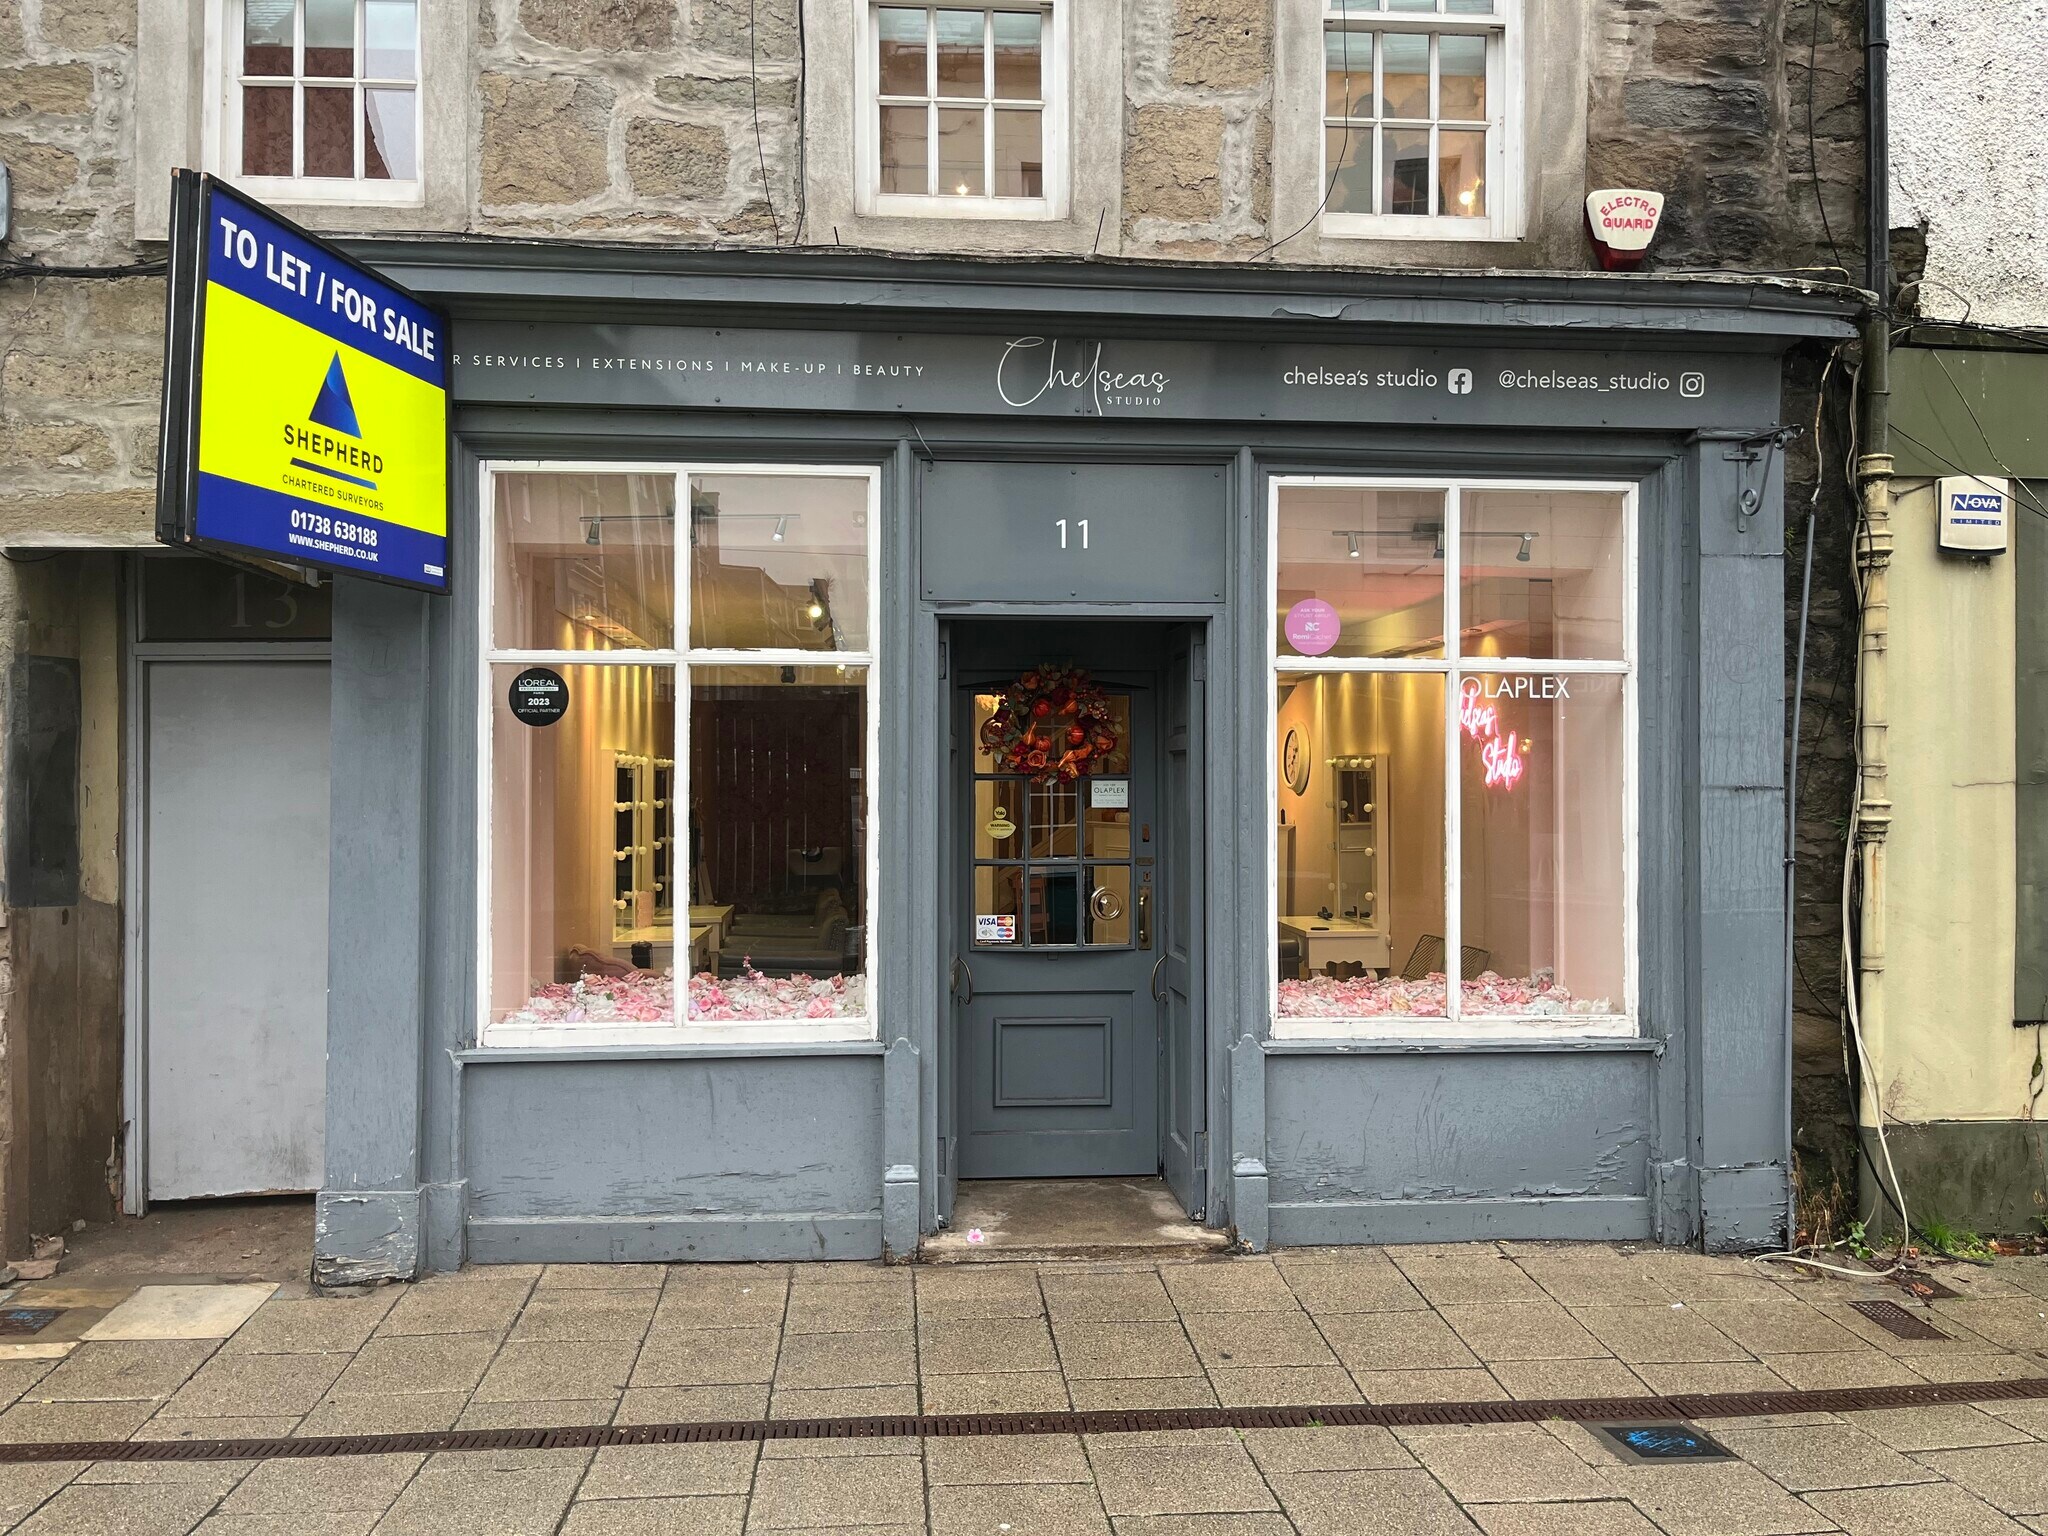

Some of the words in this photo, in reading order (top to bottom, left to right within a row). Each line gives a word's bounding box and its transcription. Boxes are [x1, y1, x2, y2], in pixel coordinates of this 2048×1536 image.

[1600, 196, 1657, 217] ELECTRO
[1602, 217, 1654, 229] GUARD
[220, 217, 258, 269] TO
[266, 242, 311, 298] LET
[316, 271, 326, 305] /
[331, 278, 377, 333] FOR
[383, 307, 435, 361] SALE
[473, 355, 565, 368] SERVICES
[592, 358, 714, 371] EXTENSIONS
[741, 361, 826, 374] MAKE-UP
[853, 364, 925, 377] BEAUTY
[997, 336, 1171, 417] Chelseas
[1283, 365, 1369, 386] chelsea's
[1376, 367, 1438, 387] studio
[1499, 369, 1670, 392] @chelseas_studio
[1106, 396, 1161, 406] STUDIO
[283, 424, 384, 474] SHEPHERD
[282, 474, 335, 497] CHARTERED
[337, 490, 384, 511] SURVEYORS
[1952, 495, 2001, 510] NOVA
[291, 509, 331, 536] 01738
[334, 520, 378, 547] 638188
[1055, 519, 1089, 549] 11
[288, 533, 379, 562] WWW.SHEPHERD.CO.UK
[229, 571, 298, 628] 13
[1460, 676, 1571, 699] OLAPLEX
[527, 698, 550, 706] 2023
[1093, 786, 1125, 794] OLAPLEX
[978, 917, 996, 926] VISA
